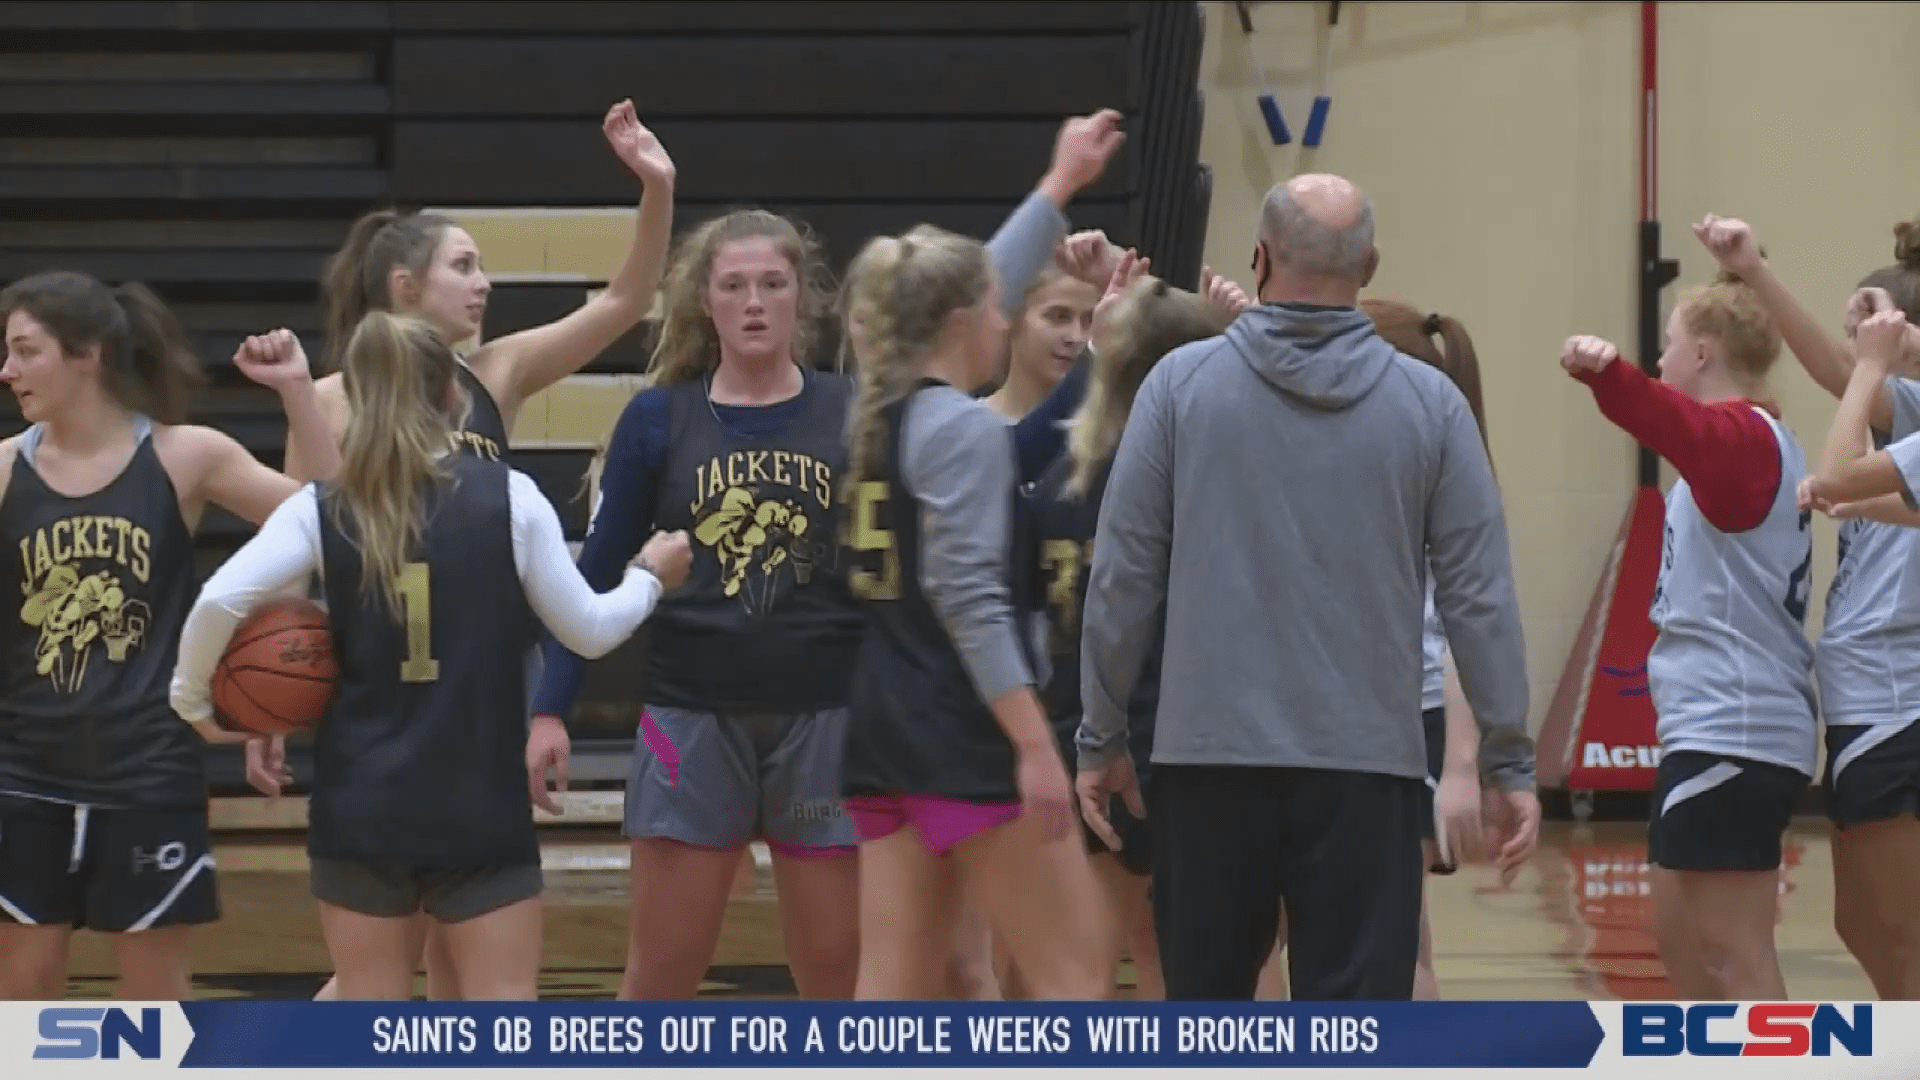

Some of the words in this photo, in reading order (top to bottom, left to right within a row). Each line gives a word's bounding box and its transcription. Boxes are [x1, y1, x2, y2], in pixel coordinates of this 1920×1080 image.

[687, 449, 832, 516] JACKETS
[18, 514, 151, 596] JACKETS
[395, 562, 440, 683] 1
